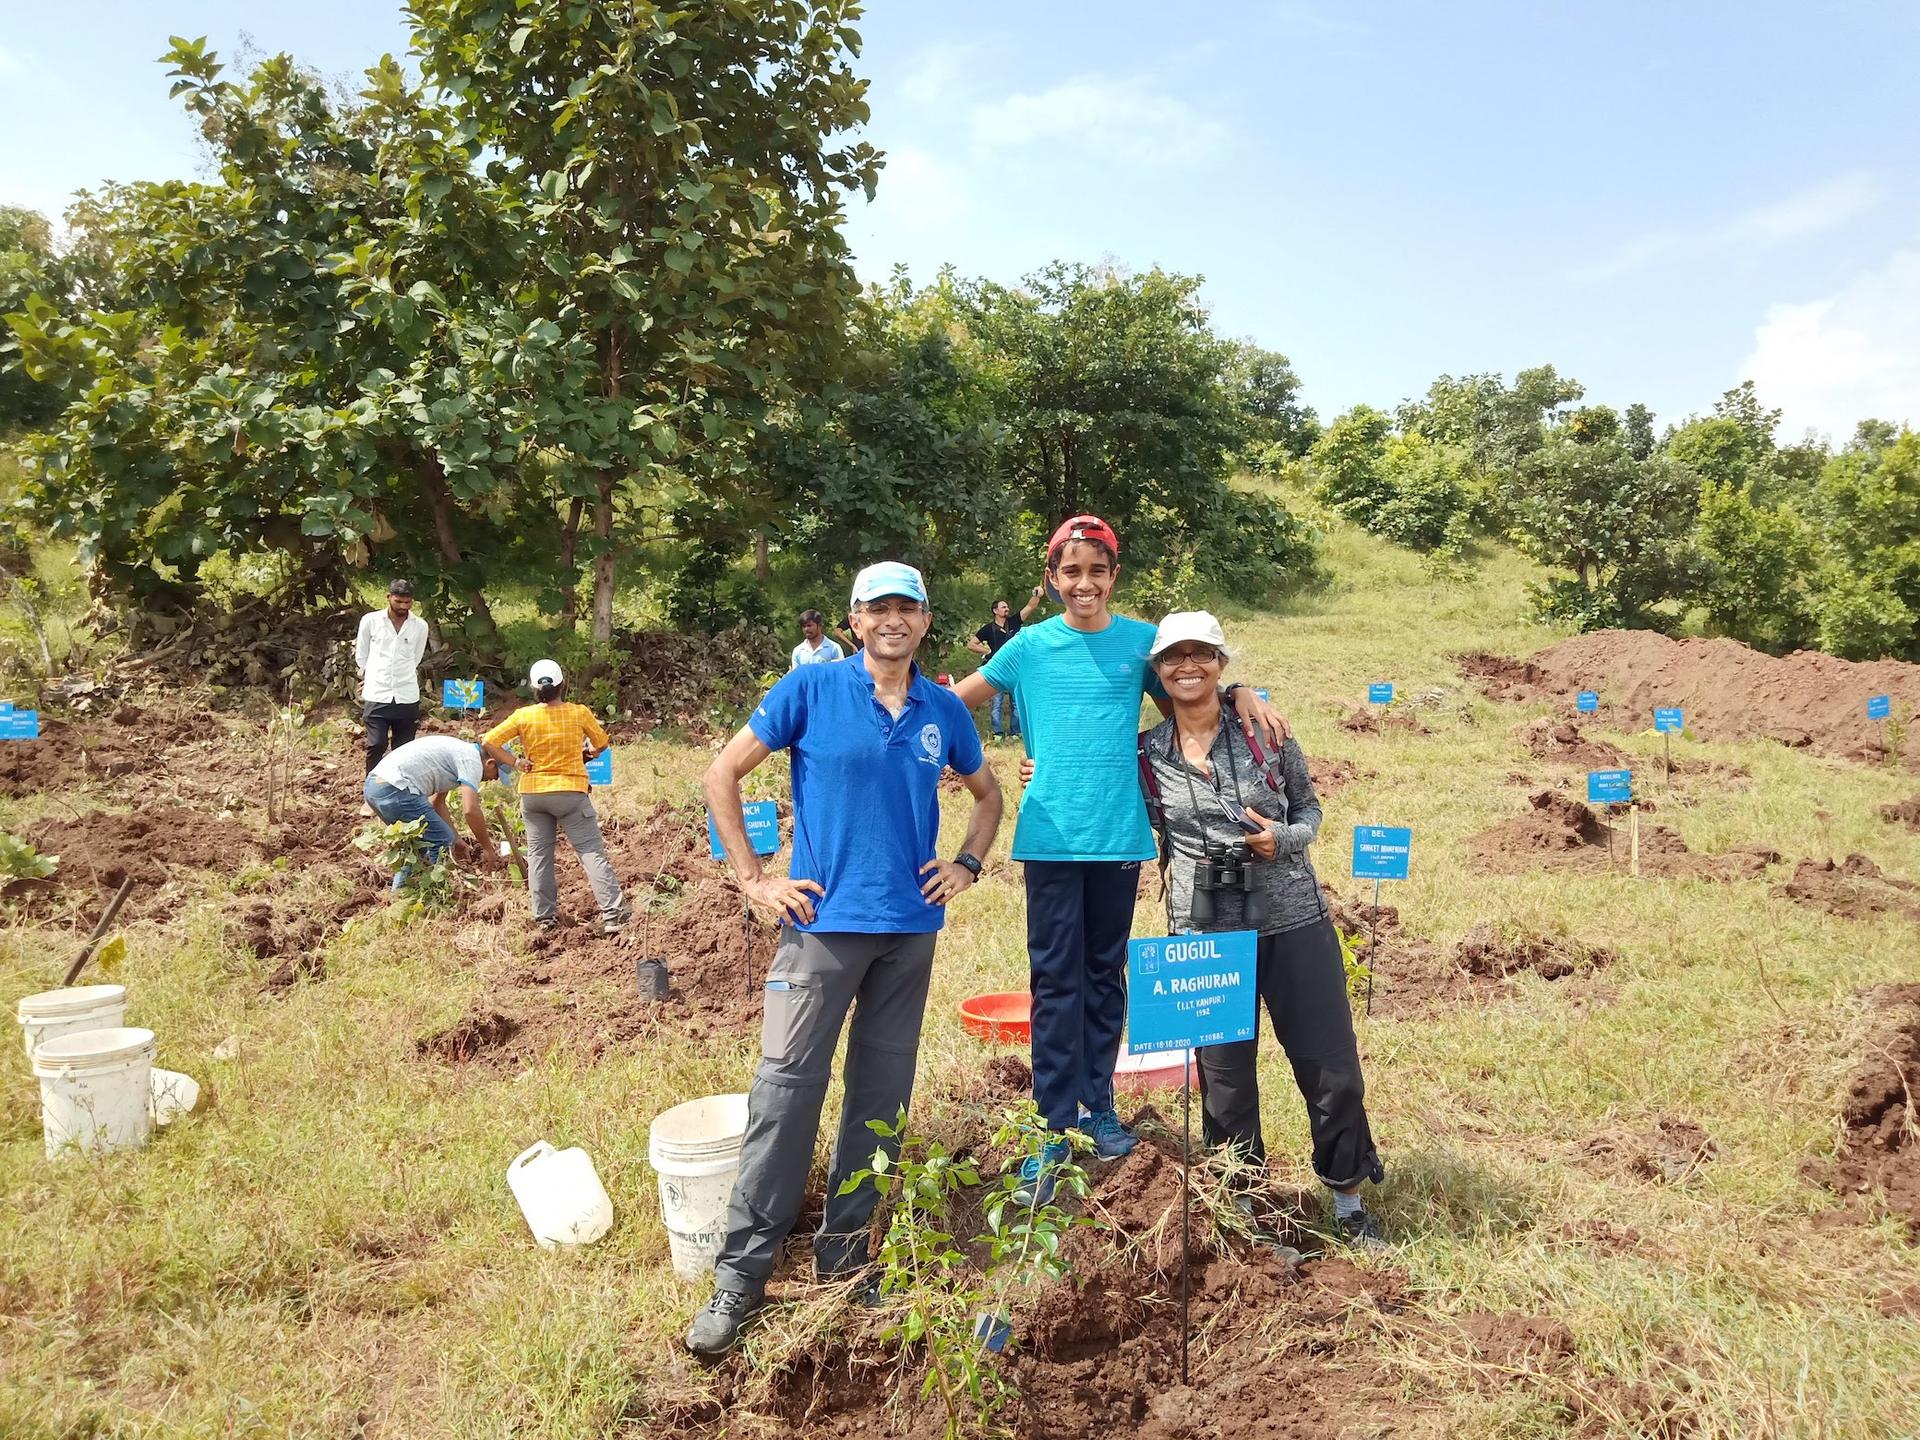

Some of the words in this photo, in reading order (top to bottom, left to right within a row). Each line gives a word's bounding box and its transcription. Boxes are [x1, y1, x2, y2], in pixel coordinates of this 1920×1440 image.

[1371, 829, 1387, 838] BEL
[1165, 940, 1222, 963] GUGUL
[1153, 980, 1168, 996] A.
[1171, 972, 1240, 994] RAGHURAM
